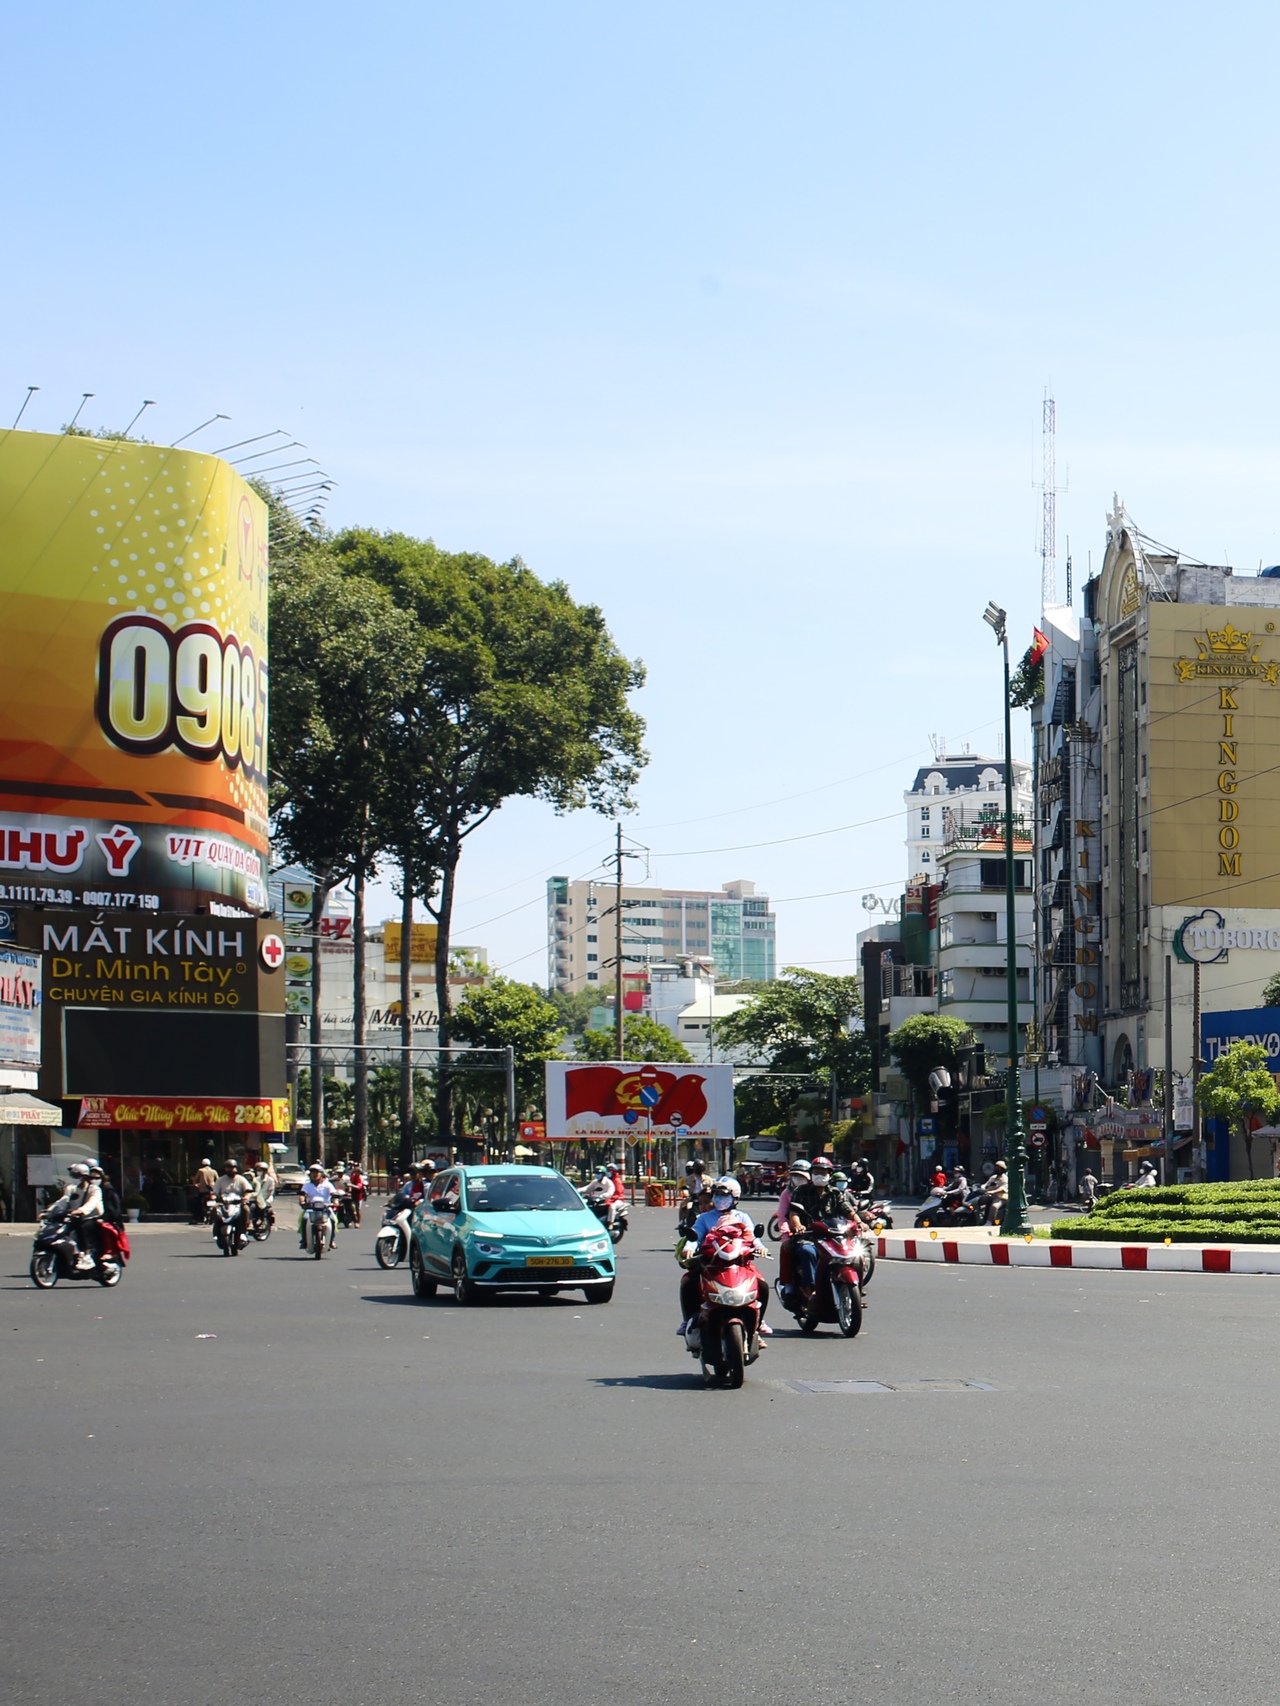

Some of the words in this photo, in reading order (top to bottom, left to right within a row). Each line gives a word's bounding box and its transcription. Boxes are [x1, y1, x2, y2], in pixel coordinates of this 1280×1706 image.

[1195, 664, 1259, 677] KINGDOM
[1218, 686, 1241, 876] KINGDOM
[169, 837, 205, 860] VỊT
[208, 842, 234, 864] QUAY
[907, 888, 921, 898] 51
[43, 912, 132, 954] MẮT
[146, 920, 243, 957] KÍNH
[1073, 820, 1098, 1031] KINGDOM
[97, 959, 170, 981] Minh
[181, 961, 232, 987] Tây
[49, 986, 124, 1002] CHUYÊN
[130, 990, 163, 1003] GIA
[169, 987, 208, 1004] KÍNH
[214, 989, 239, 1008] ĐỘ
[115, 1104, 139, 1123] Chúc
[175, 1103, 202, 1123] Năm
